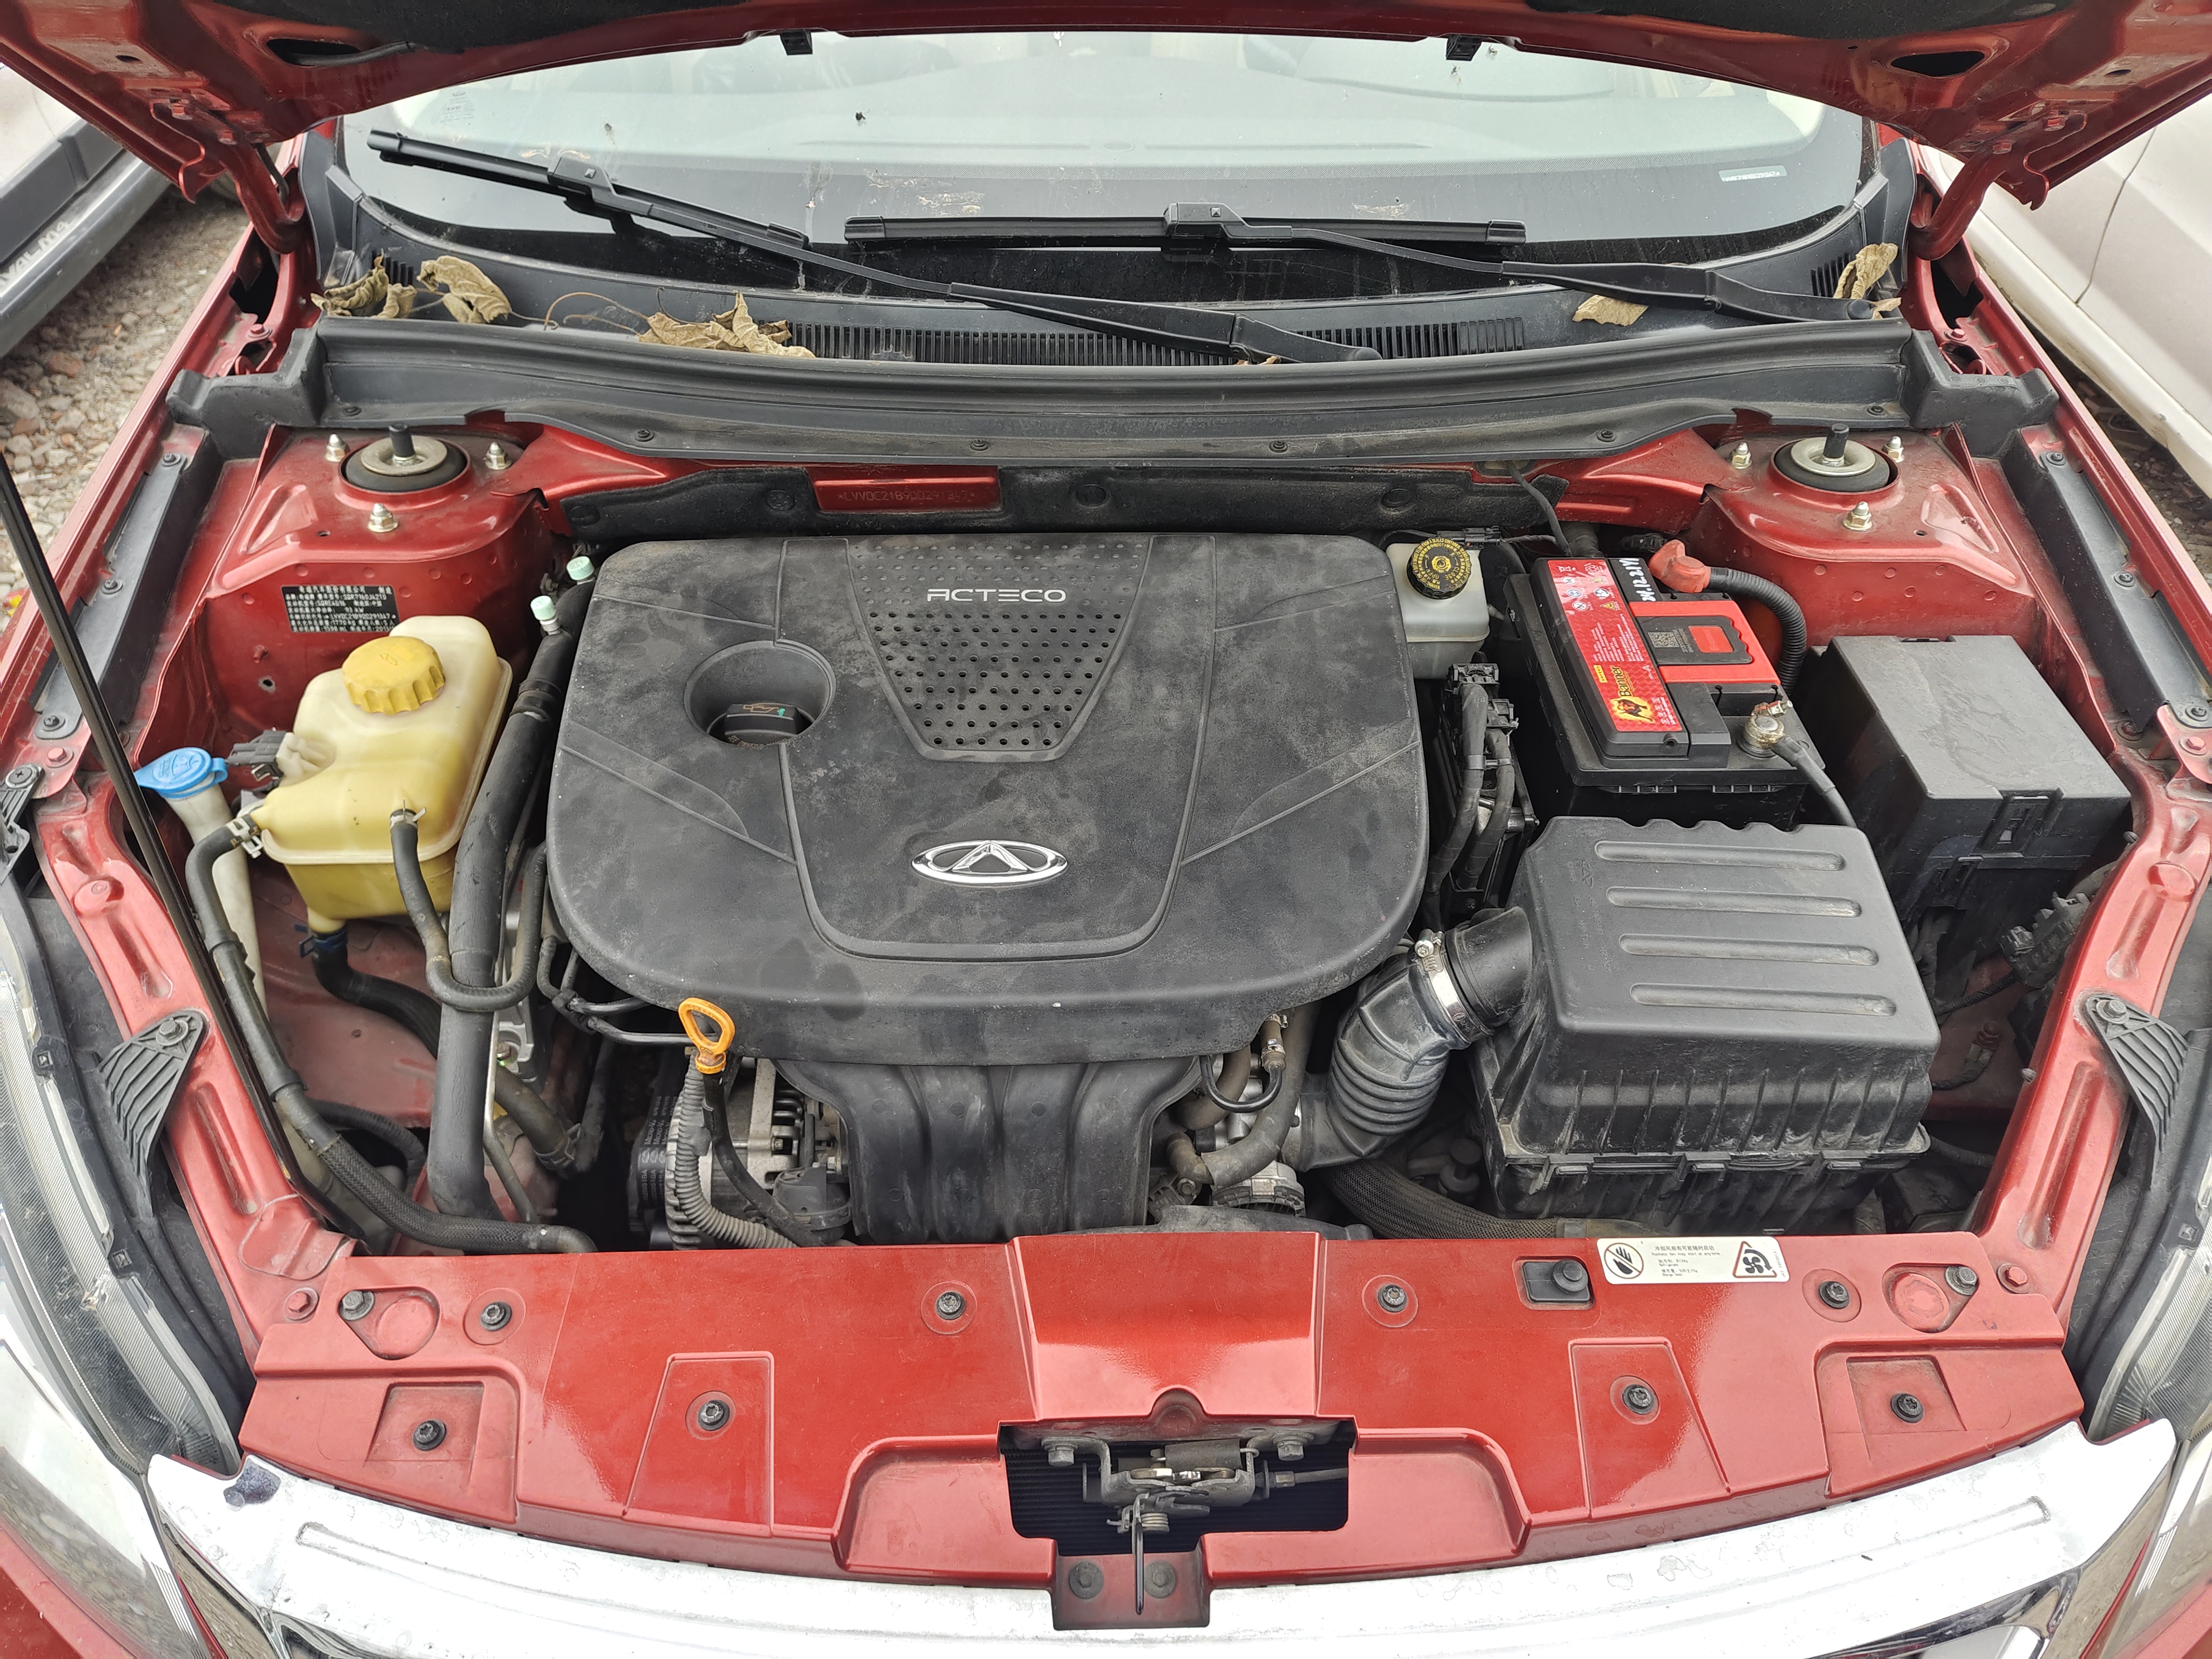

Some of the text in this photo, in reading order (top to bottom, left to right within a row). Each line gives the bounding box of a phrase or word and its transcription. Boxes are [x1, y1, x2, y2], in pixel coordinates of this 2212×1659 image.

[1444, 567, 1460, 581] CLOSE
[927, 589, 1066, 602] ACTECO
[1611, 666, 1631, 696] Banner
